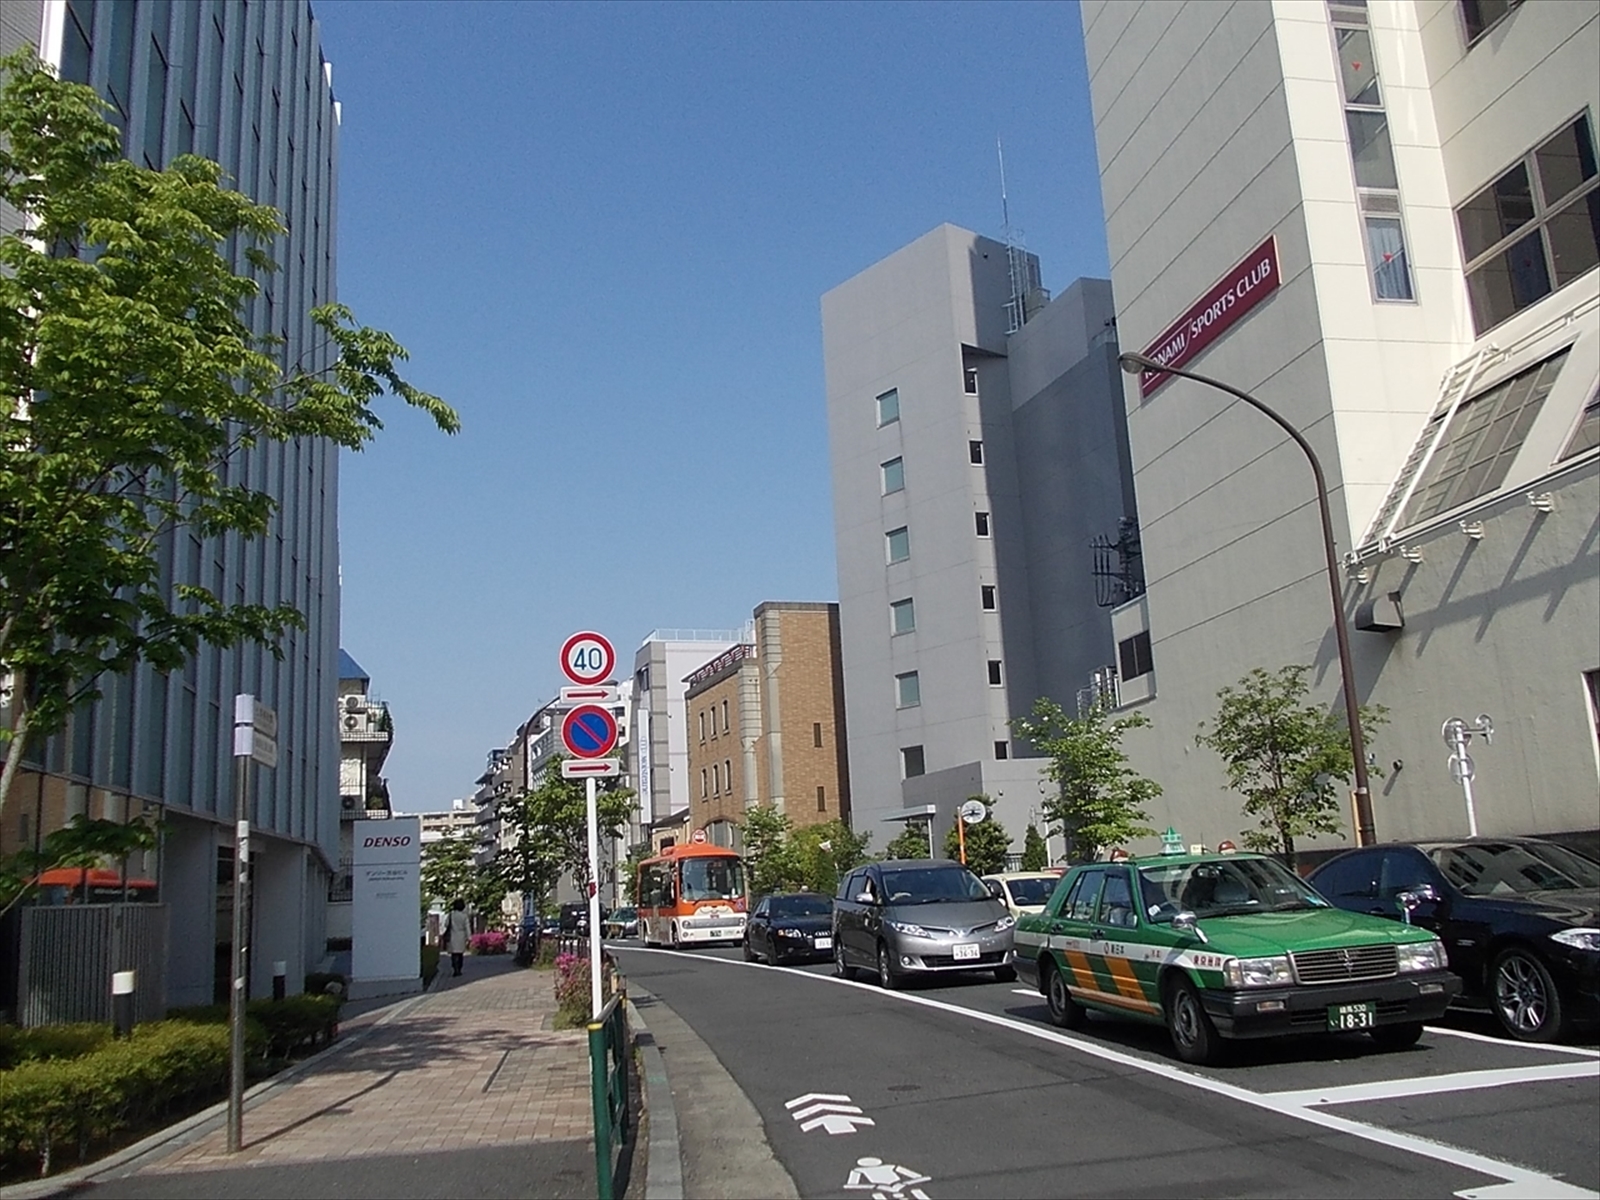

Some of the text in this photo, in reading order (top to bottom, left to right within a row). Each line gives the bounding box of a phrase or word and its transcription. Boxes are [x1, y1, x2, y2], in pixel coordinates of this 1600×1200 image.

[1192, 289, 1235, 339] SPORTS
[1236, 258, 1271, 298] CLUB
[573, 647, 602, 671] 40
[363, 836, 411, 848] DENSO
[1340, 1012, 1373, 1029] 18-31
